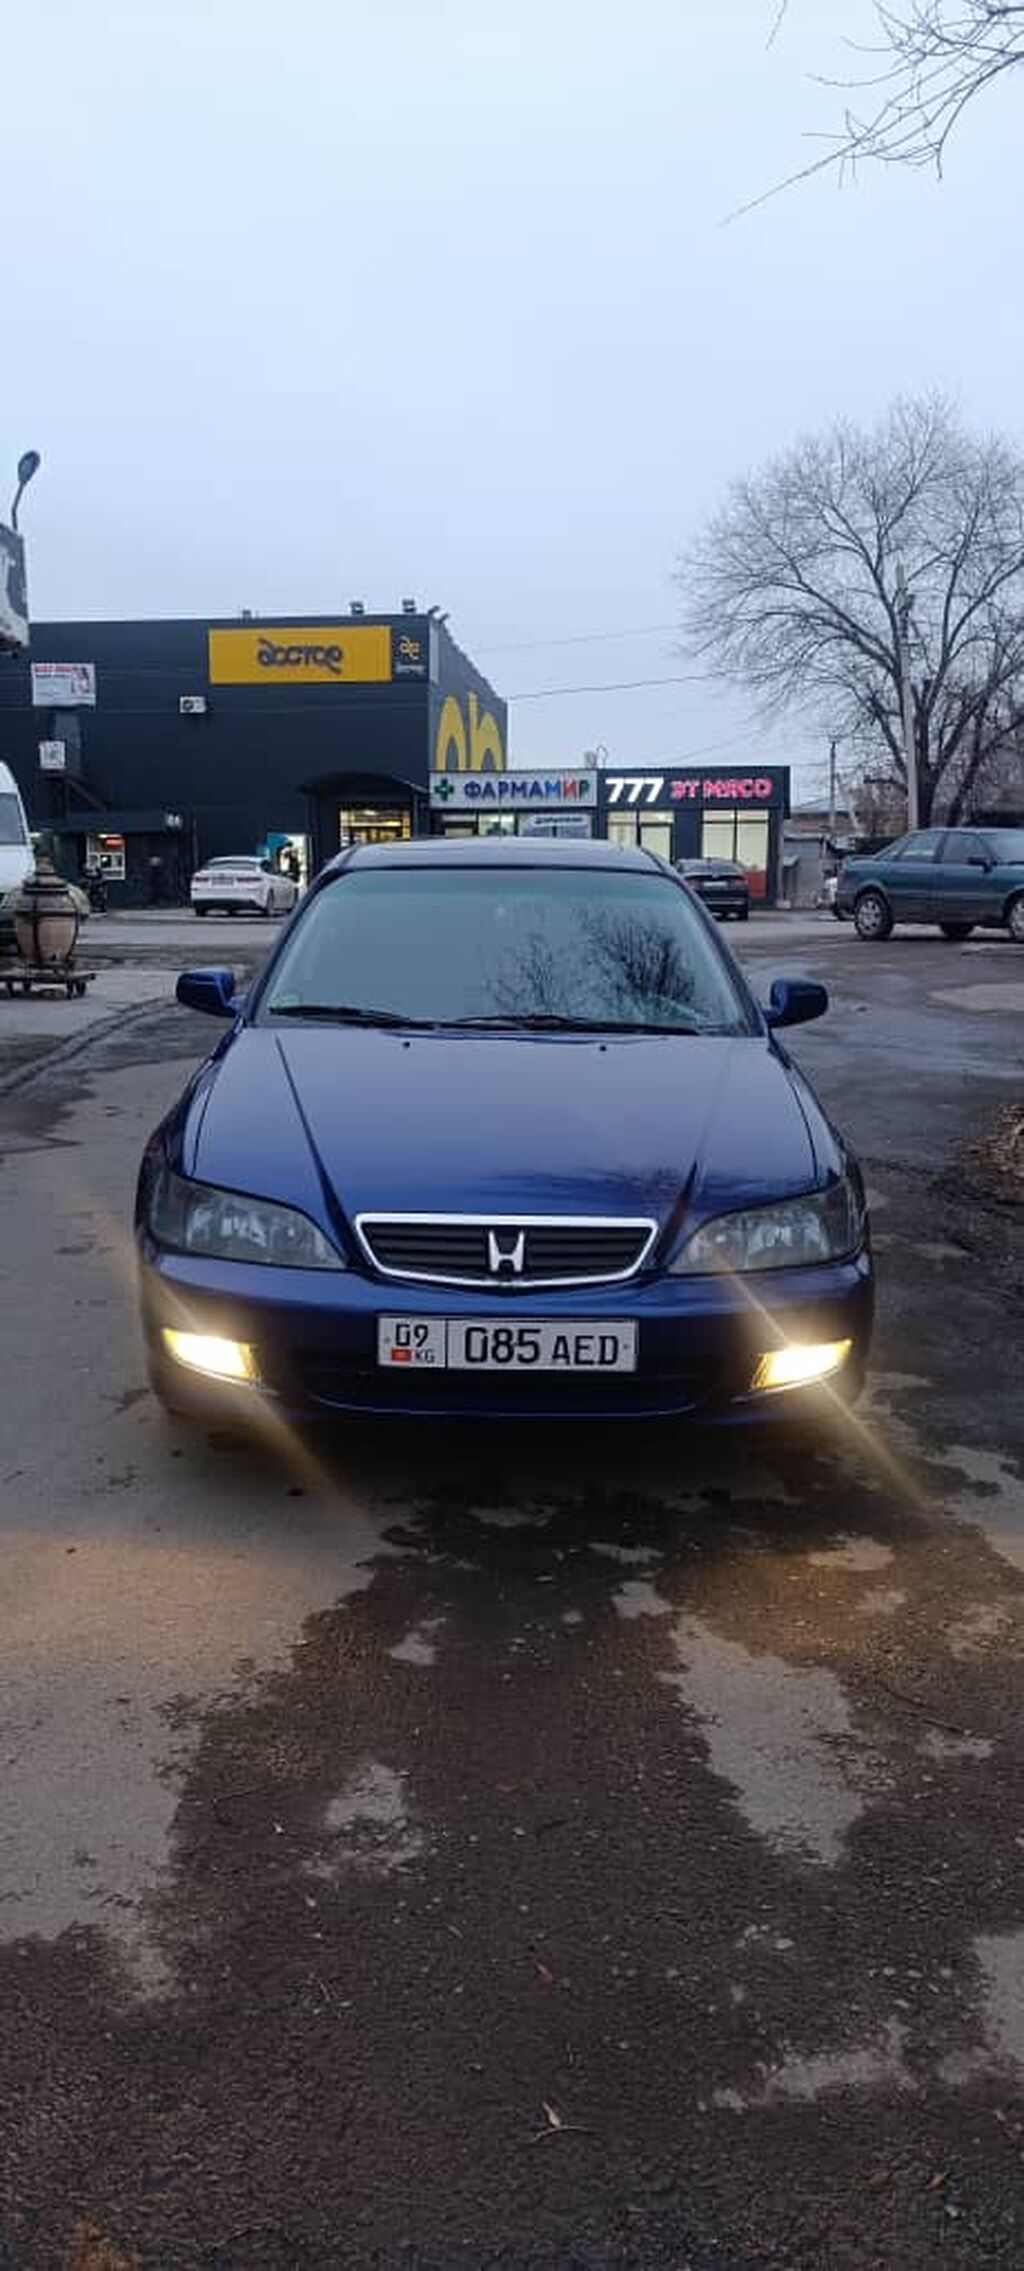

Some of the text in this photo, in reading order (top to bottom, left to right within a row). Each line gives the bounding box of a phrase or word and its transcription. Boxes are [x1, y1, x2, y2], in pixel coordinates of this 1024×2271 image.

[463, 776, 590, 799] ФАРМАМИР
[605, 777, 664, 803] 777
[702, 777, 773, 799] МЯСО
[394, 1323, 429, 1347] 09
[463, 1327, 619, 1366] 085 AED
[414, 1348, 436, 1364] KG
